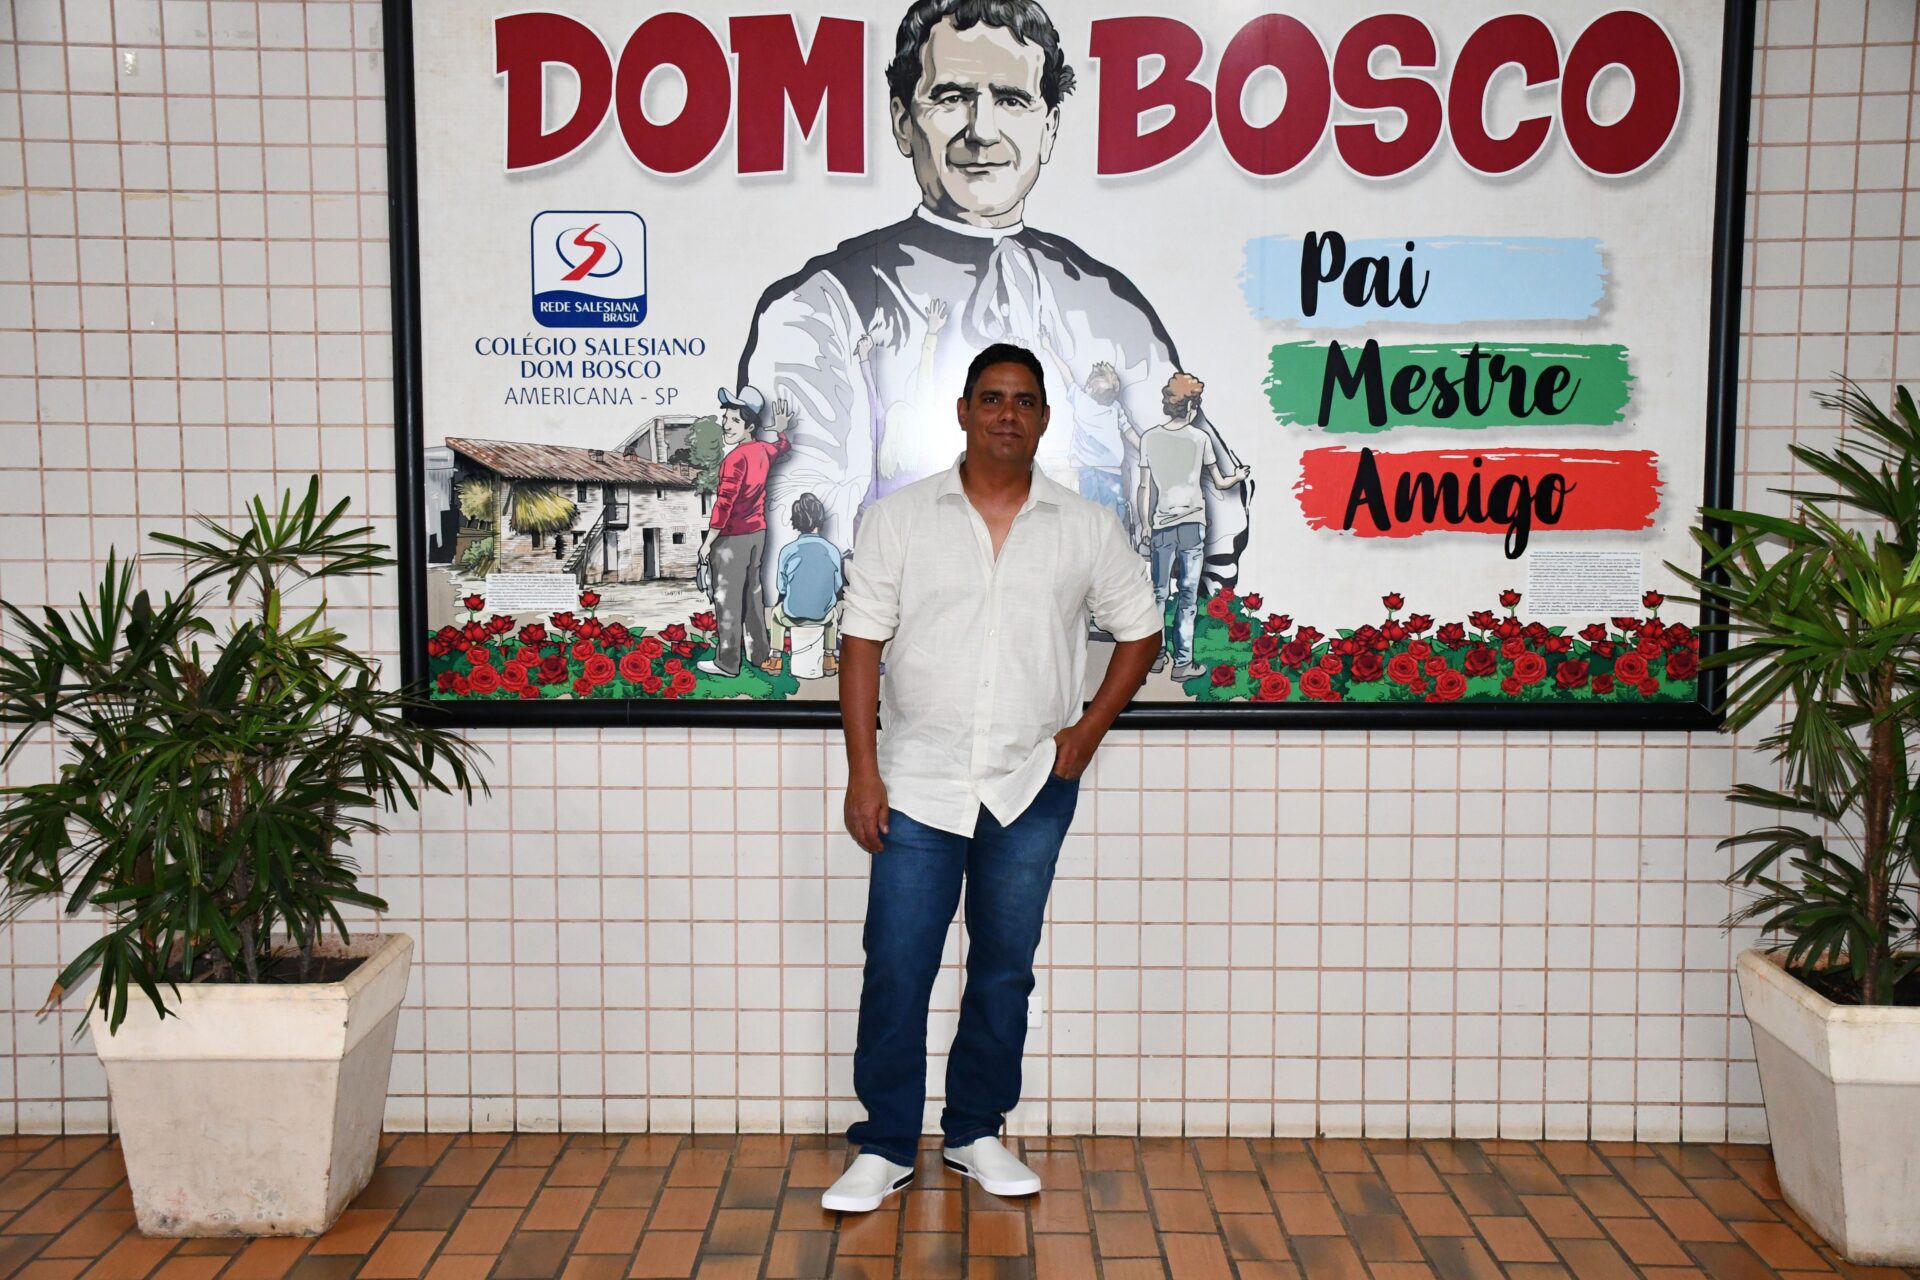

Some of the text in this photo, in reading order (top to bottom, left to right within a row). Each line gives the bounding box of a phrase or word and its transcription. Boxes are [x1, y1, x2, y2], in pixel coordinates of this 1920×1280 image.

[493, 10, 1682, 176] DOM BOSCO
[1301, 230, 1430, 317] Pai
[540, 301, 639, 313] REDE SALESIANA
[602, 312, 639, 323] BRASIL
[475, 332, 706, 356] COLÉGIO SALESIANO
[521, 360, 661, 379] DOM BOSCO
[1317, 338, 1581, 427] Mestre
[504, 387, 633, 405] AMERICANA
[655, 387, 679, 406] SP
[1343, 447, 1577, 560] Amigo
